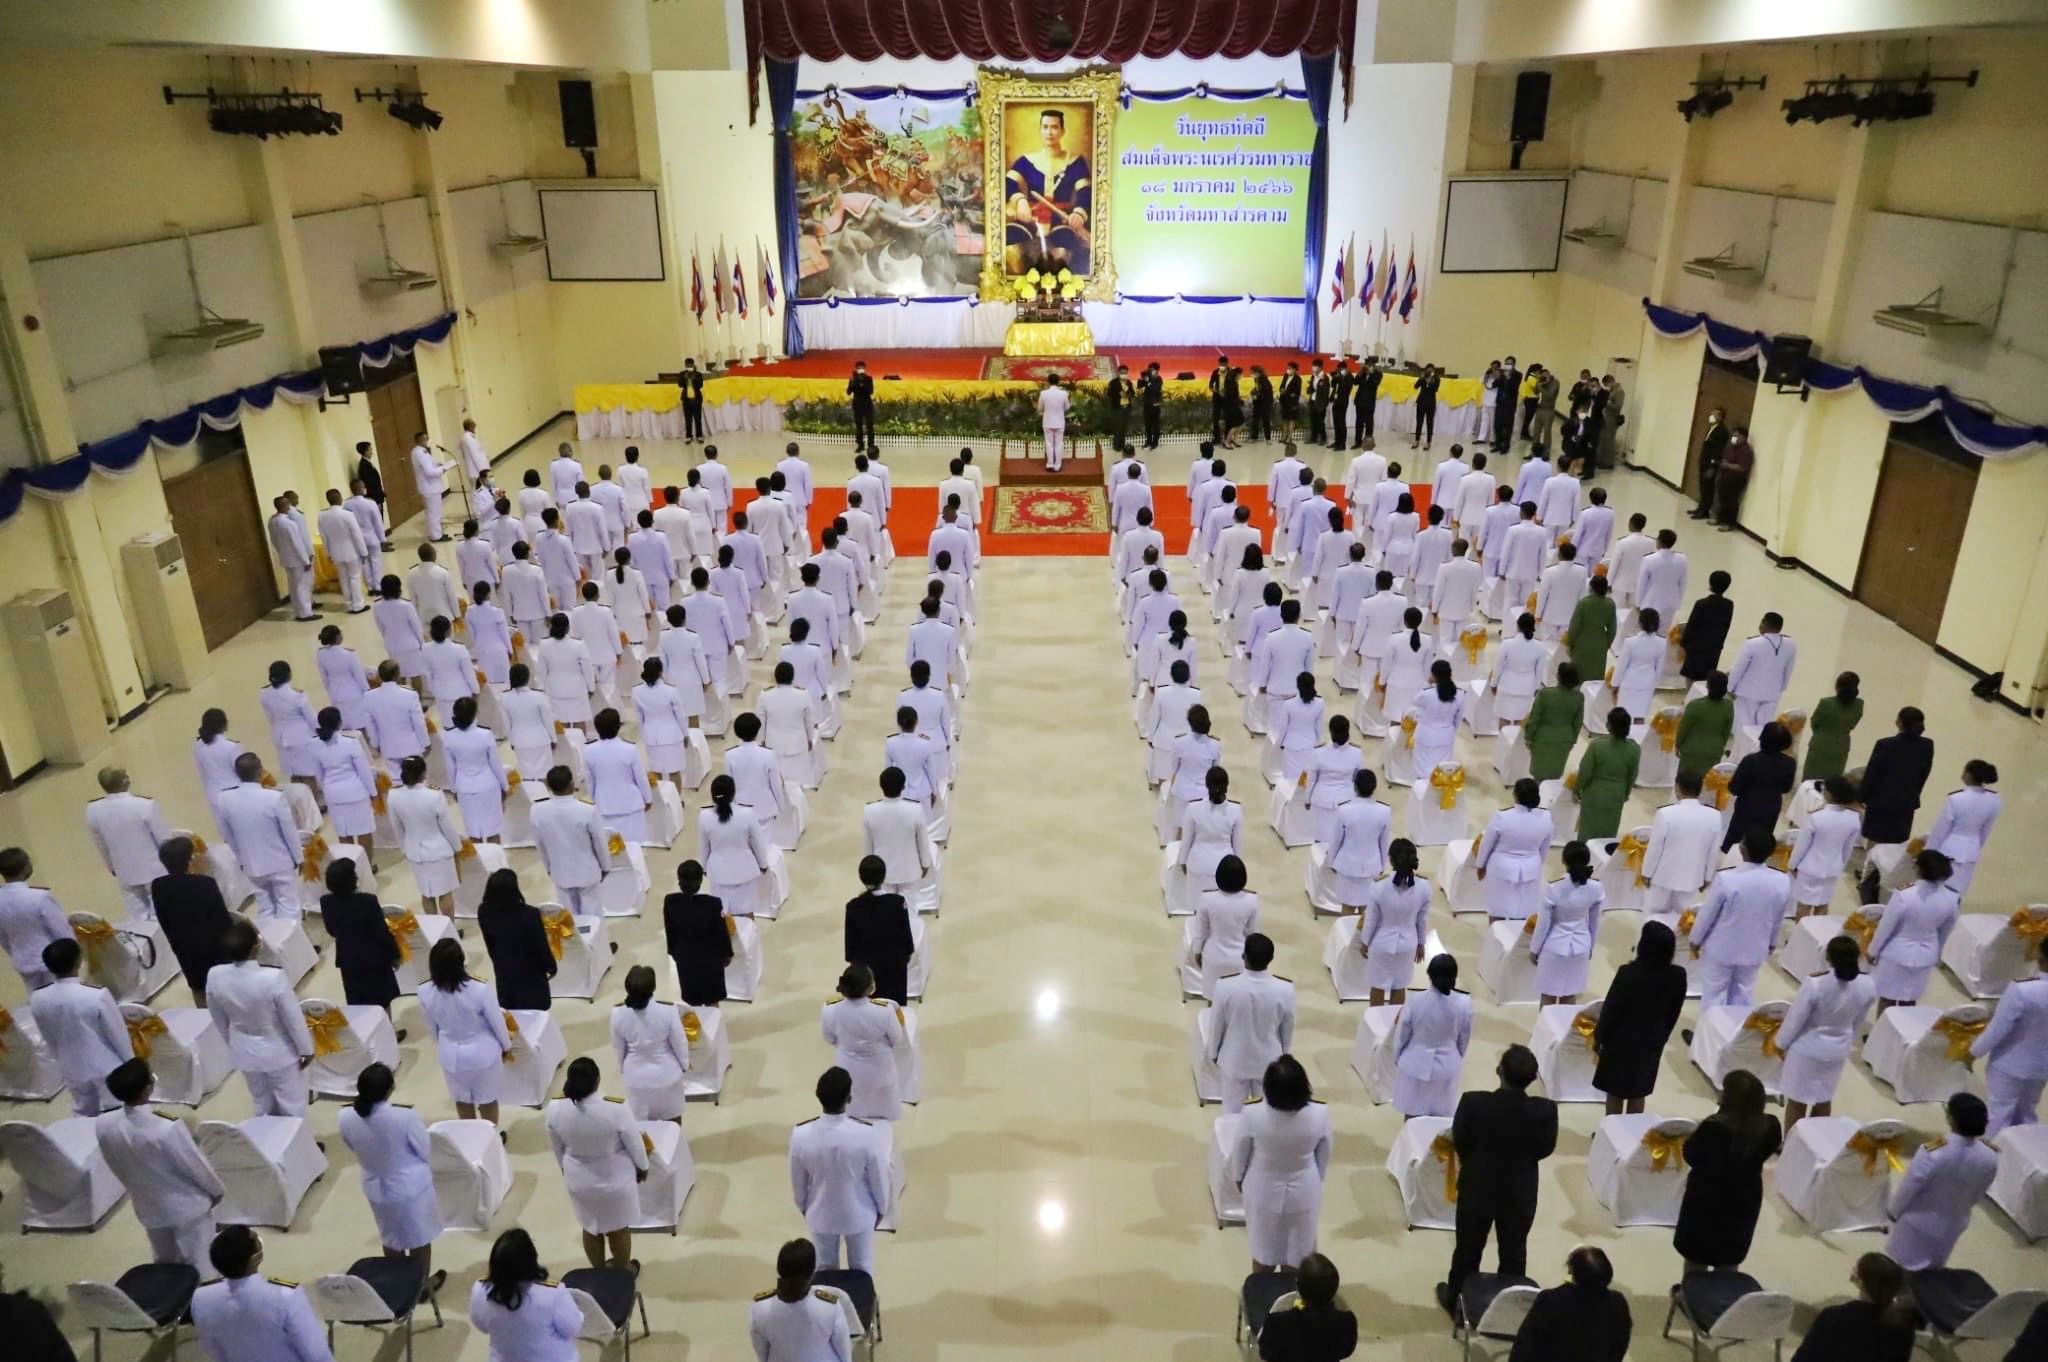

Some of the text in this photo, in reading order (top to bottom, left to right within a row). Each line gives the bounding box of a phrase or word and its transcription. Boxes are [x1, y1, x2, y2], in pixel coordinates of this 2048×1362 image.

[1141, 179, 1293, 194] ๑๘ มกราคม ๒๕๖๖
[1146, 203, 1287, 222] จังหวัดมหาสารคาม
